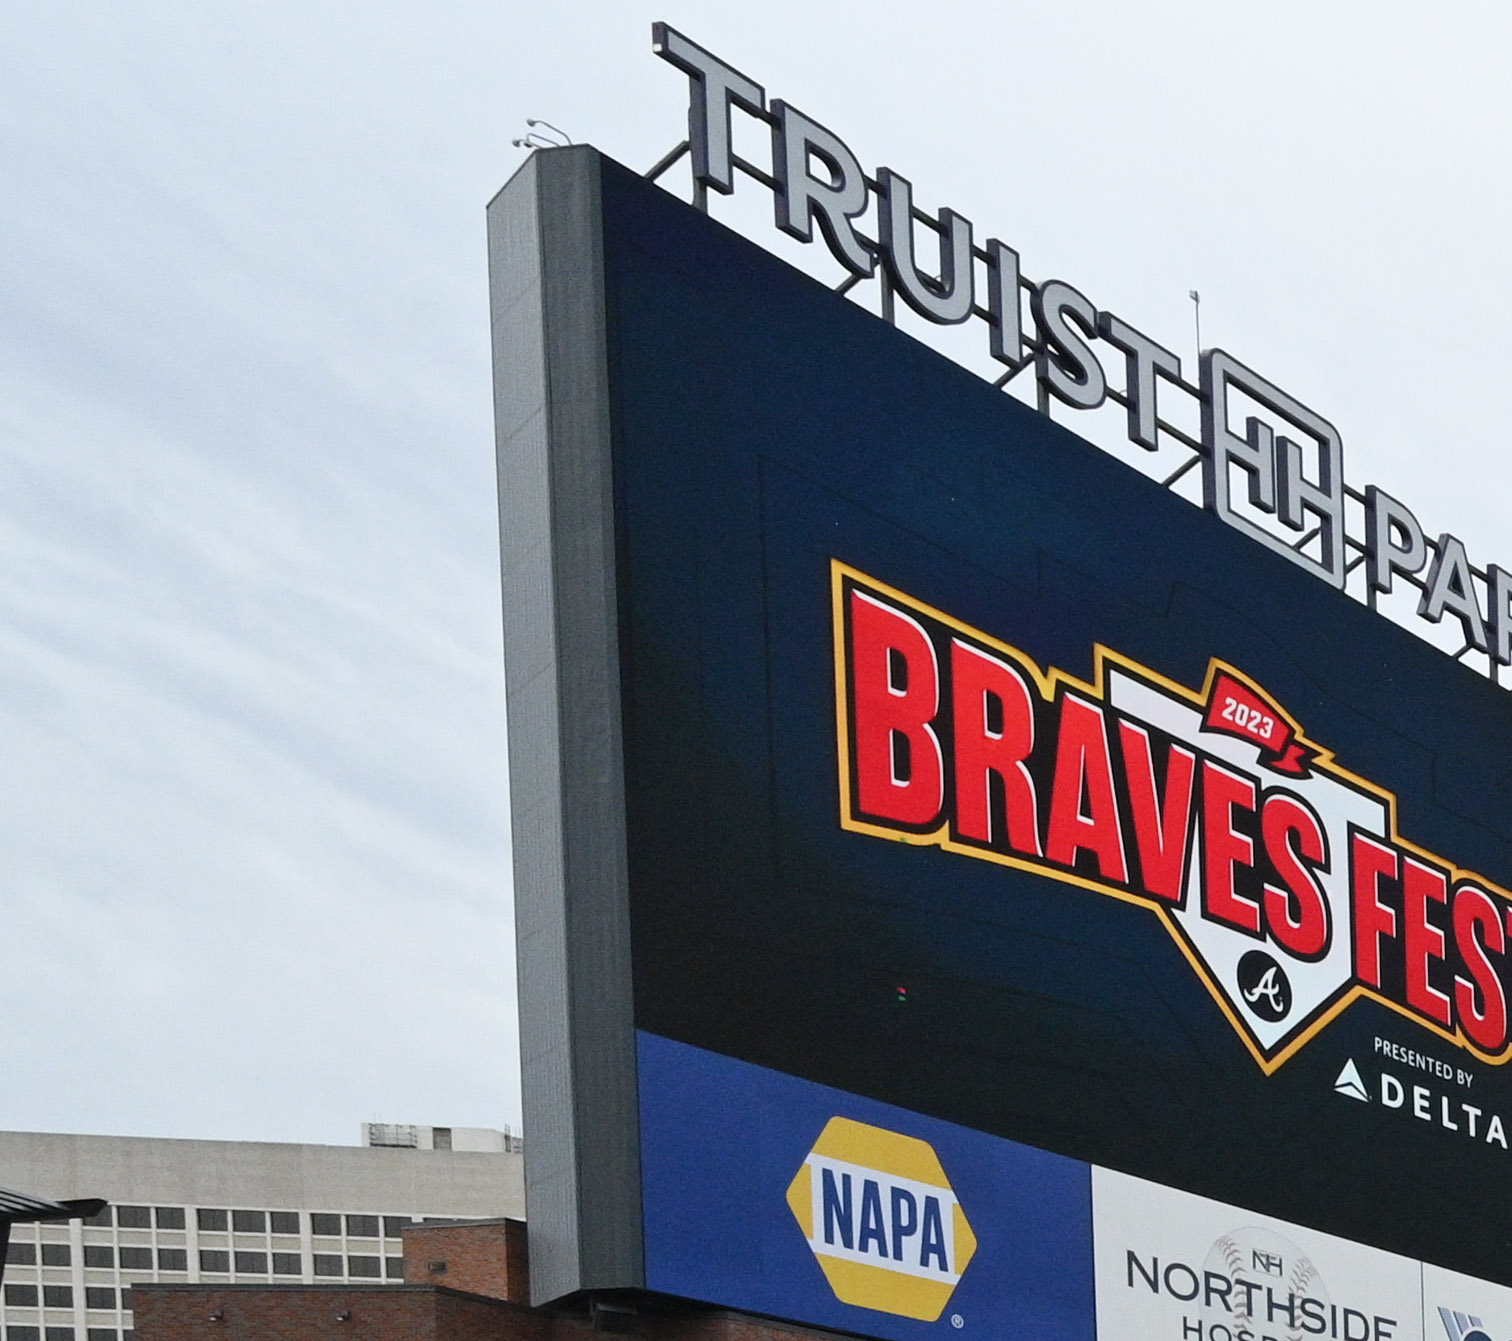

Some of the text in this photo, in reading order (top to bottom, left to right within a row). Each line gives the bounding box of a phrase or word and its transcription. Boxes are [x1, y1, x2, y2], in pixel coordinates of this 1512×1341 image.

[652, 21, 1182, 450] TRUIST
[1221, 695, 1275, 740] 2023
[850, 588, 1332, 956] BRAVES
[1373, 1036, 1474, 1089] PRESENTED BY
[1381, 1072, 1508, 1150] DELTA
[821, 1166, 949, 1273] NAPA
